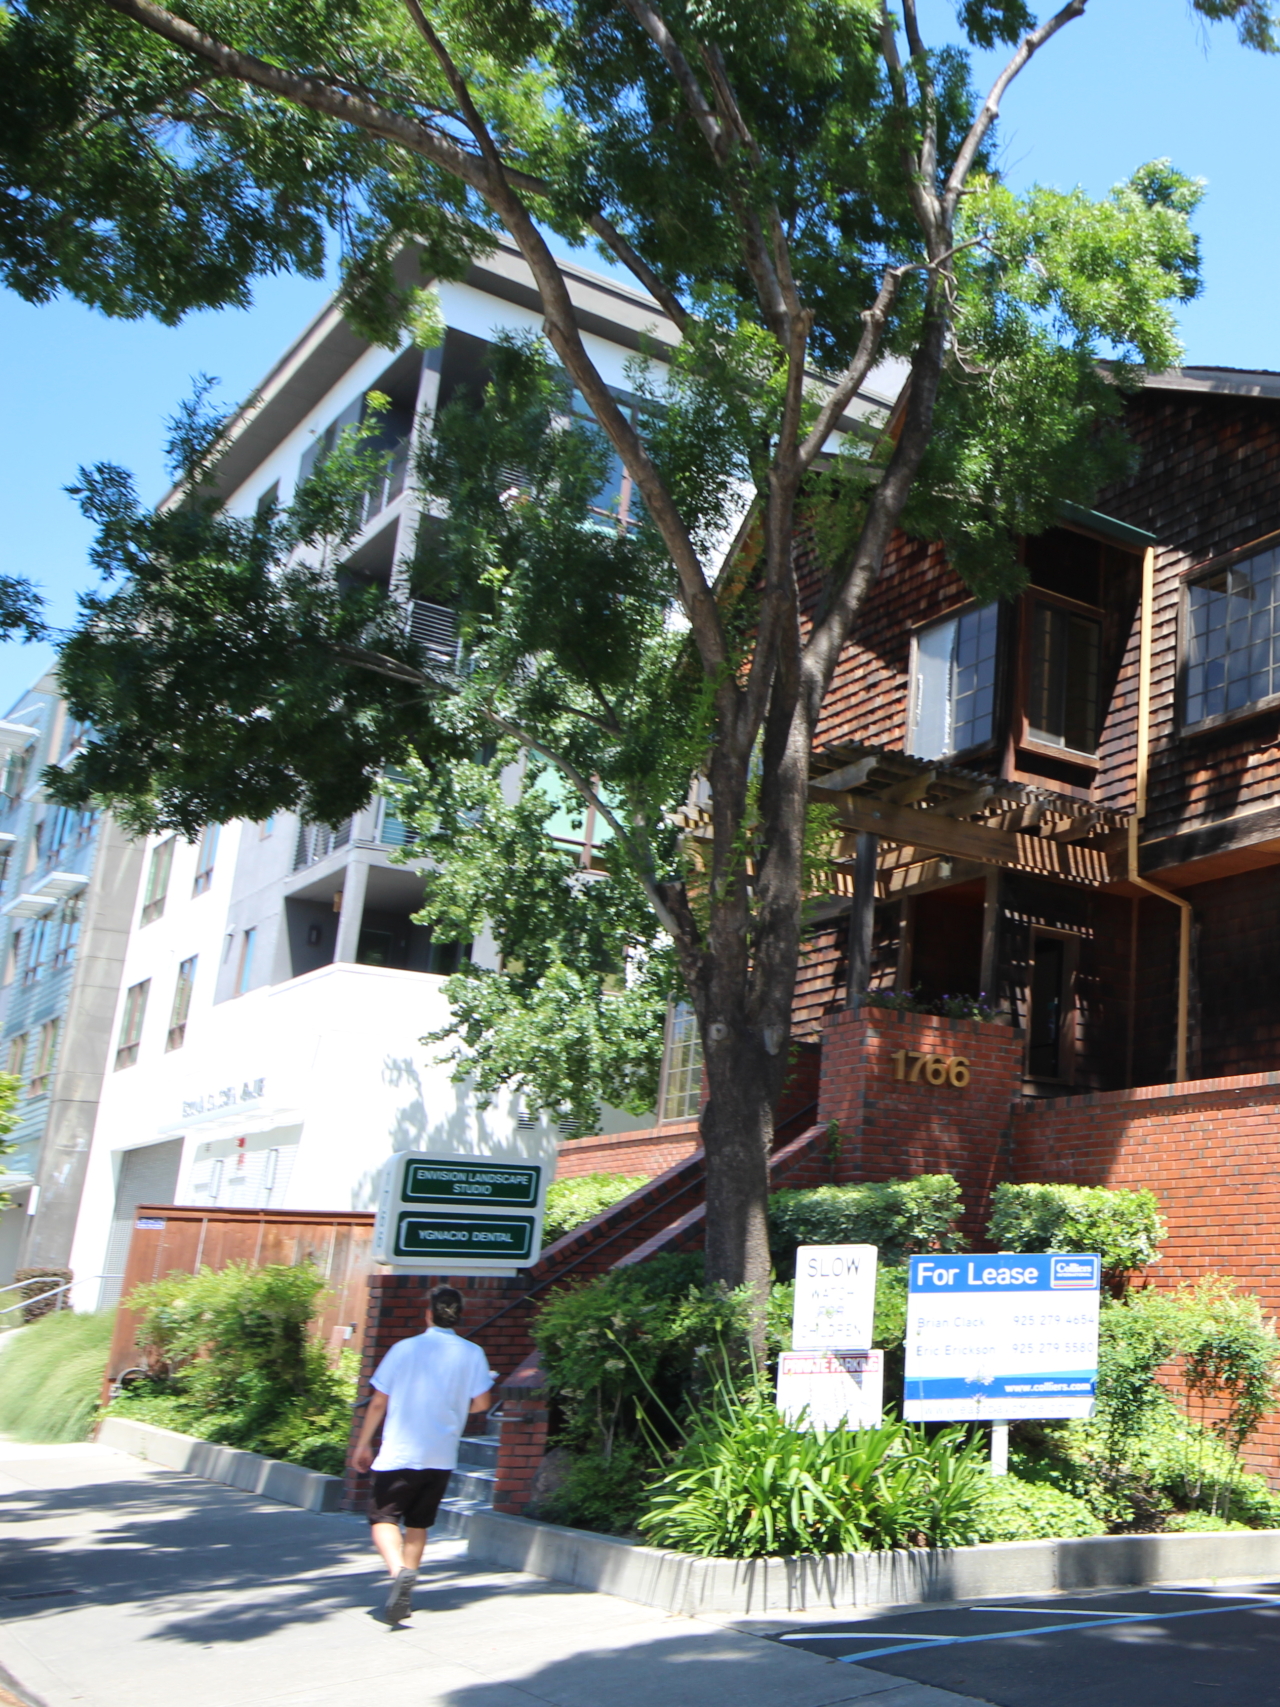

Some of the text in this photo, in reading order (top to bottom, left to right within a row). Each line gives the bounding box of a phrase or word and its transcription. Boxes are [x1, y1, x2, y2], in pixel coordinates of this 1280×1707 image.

[891, 1049, 971, 1088] 1766
[416, 1169, 530, 1185] ENVISION LANDSCAPE
[452, 1184, 492, 1195] STUDIO
[418, 1229, 514, 1242] YGNACIO DENTAL
[806, 1257, 861, 1279] SLOW
[917, 1262, 1039, 1287] For Lease
[1056, 1262, 1093, 1273] Colliers
[917, 1313, 1095, 1329] Brian Clack 925 279 4654
[916, 1341, 1095, 1357] Eric Erickson 925 279 5580
[784, 1356, 878, 1374] PRIVATE PARKING
[1003, 1381, 1092, 1394] www.colliers.com
